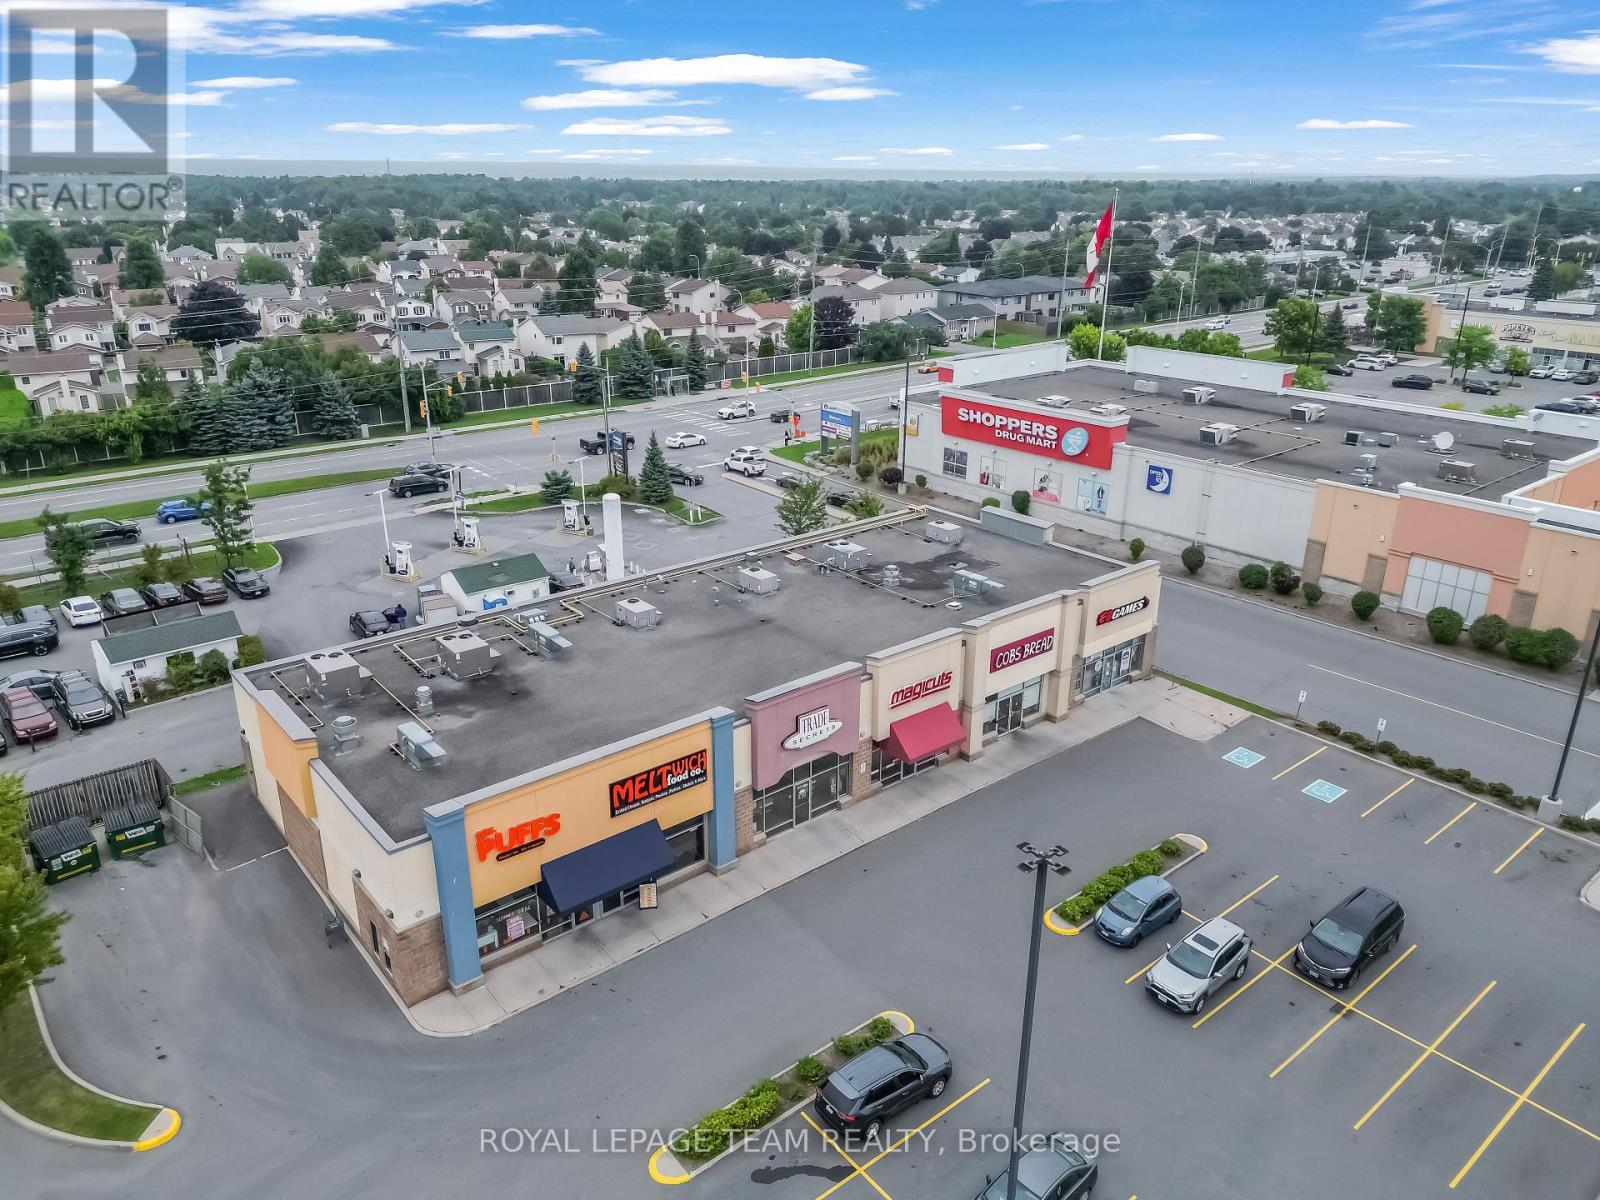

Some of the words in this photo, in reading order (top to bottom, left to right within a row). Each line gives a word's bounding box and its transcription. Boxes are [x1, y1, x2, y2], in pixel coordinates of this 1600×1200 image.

[957, 407, 1058, 439] SHOPPERS
[995, 429, 1024, 443] DRUG
[1026, 435, 1058, 449] MART
[1112, 599, 1145, 620] GAMES
[995, 646, 1022, 668] COBS
[1022, 635, 1054, 659] BREAD
[890, 671, 953, 707] magicuts
[801, 710, 829, 734] TRADE
[792, 724, 837, 746] SECRETS
[666, 770, 689, 786] food
